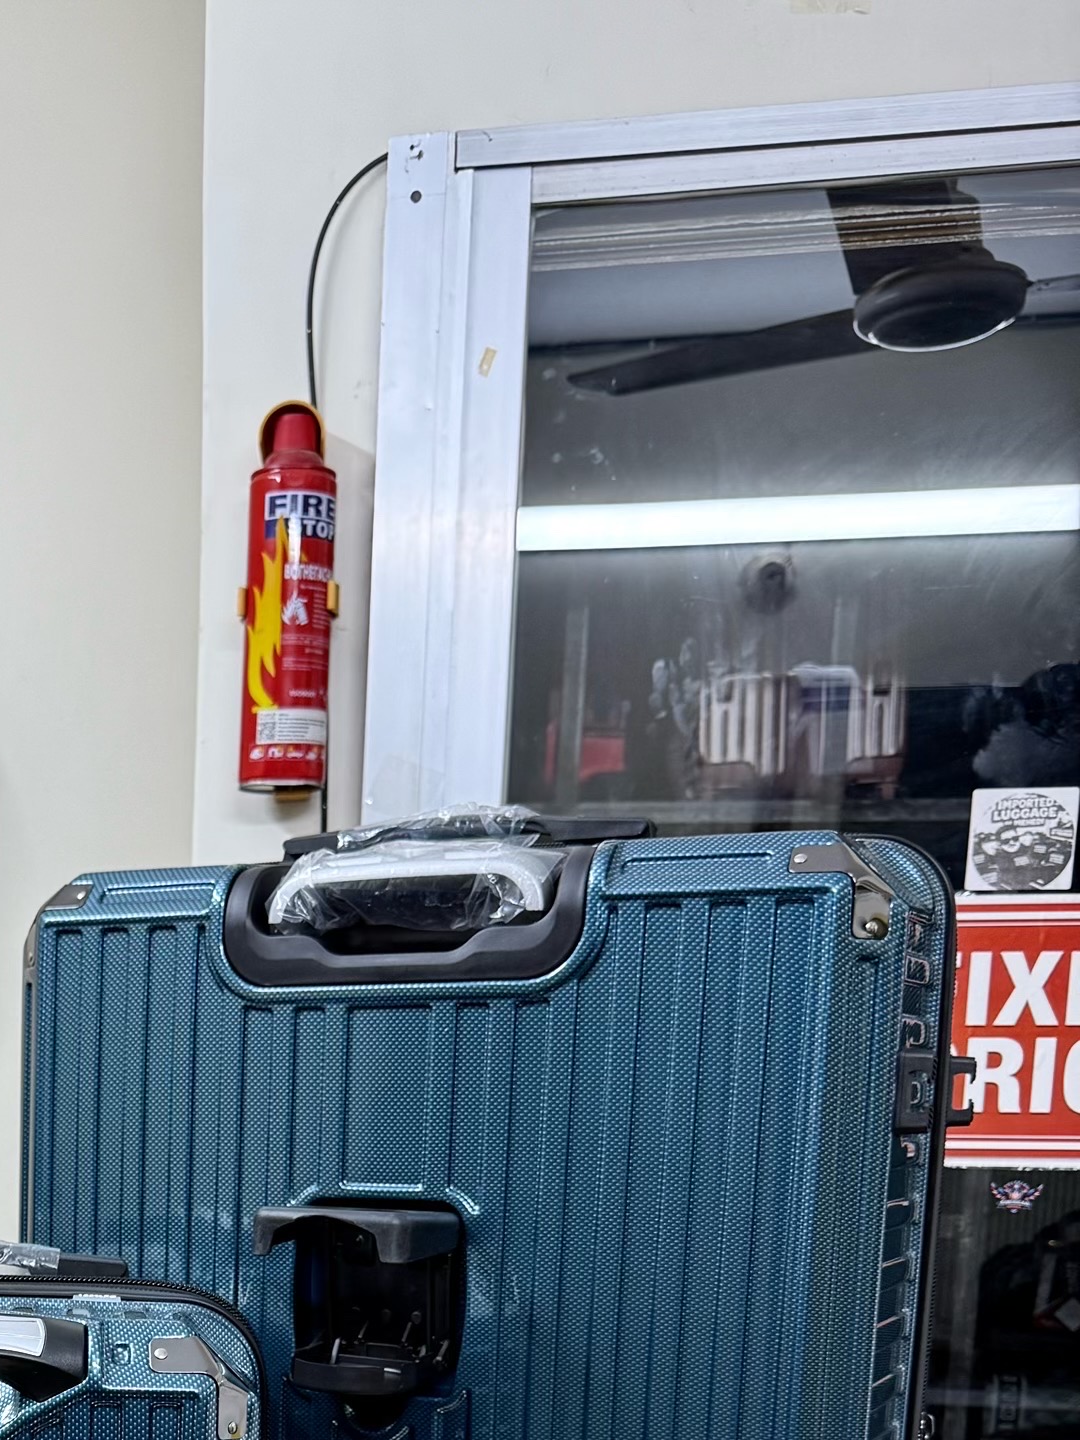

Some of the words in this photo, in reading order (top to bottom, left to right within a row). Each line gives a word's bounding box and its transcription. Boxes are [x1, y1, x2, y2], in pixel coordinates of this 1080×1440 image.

[268, 493, 335, 520] FIRE
[992, 806, 1058, 821] LUGGAGE
[996, 797, 1054, 810] IMPORTED
[954, 951, 1080, 1026] IX
